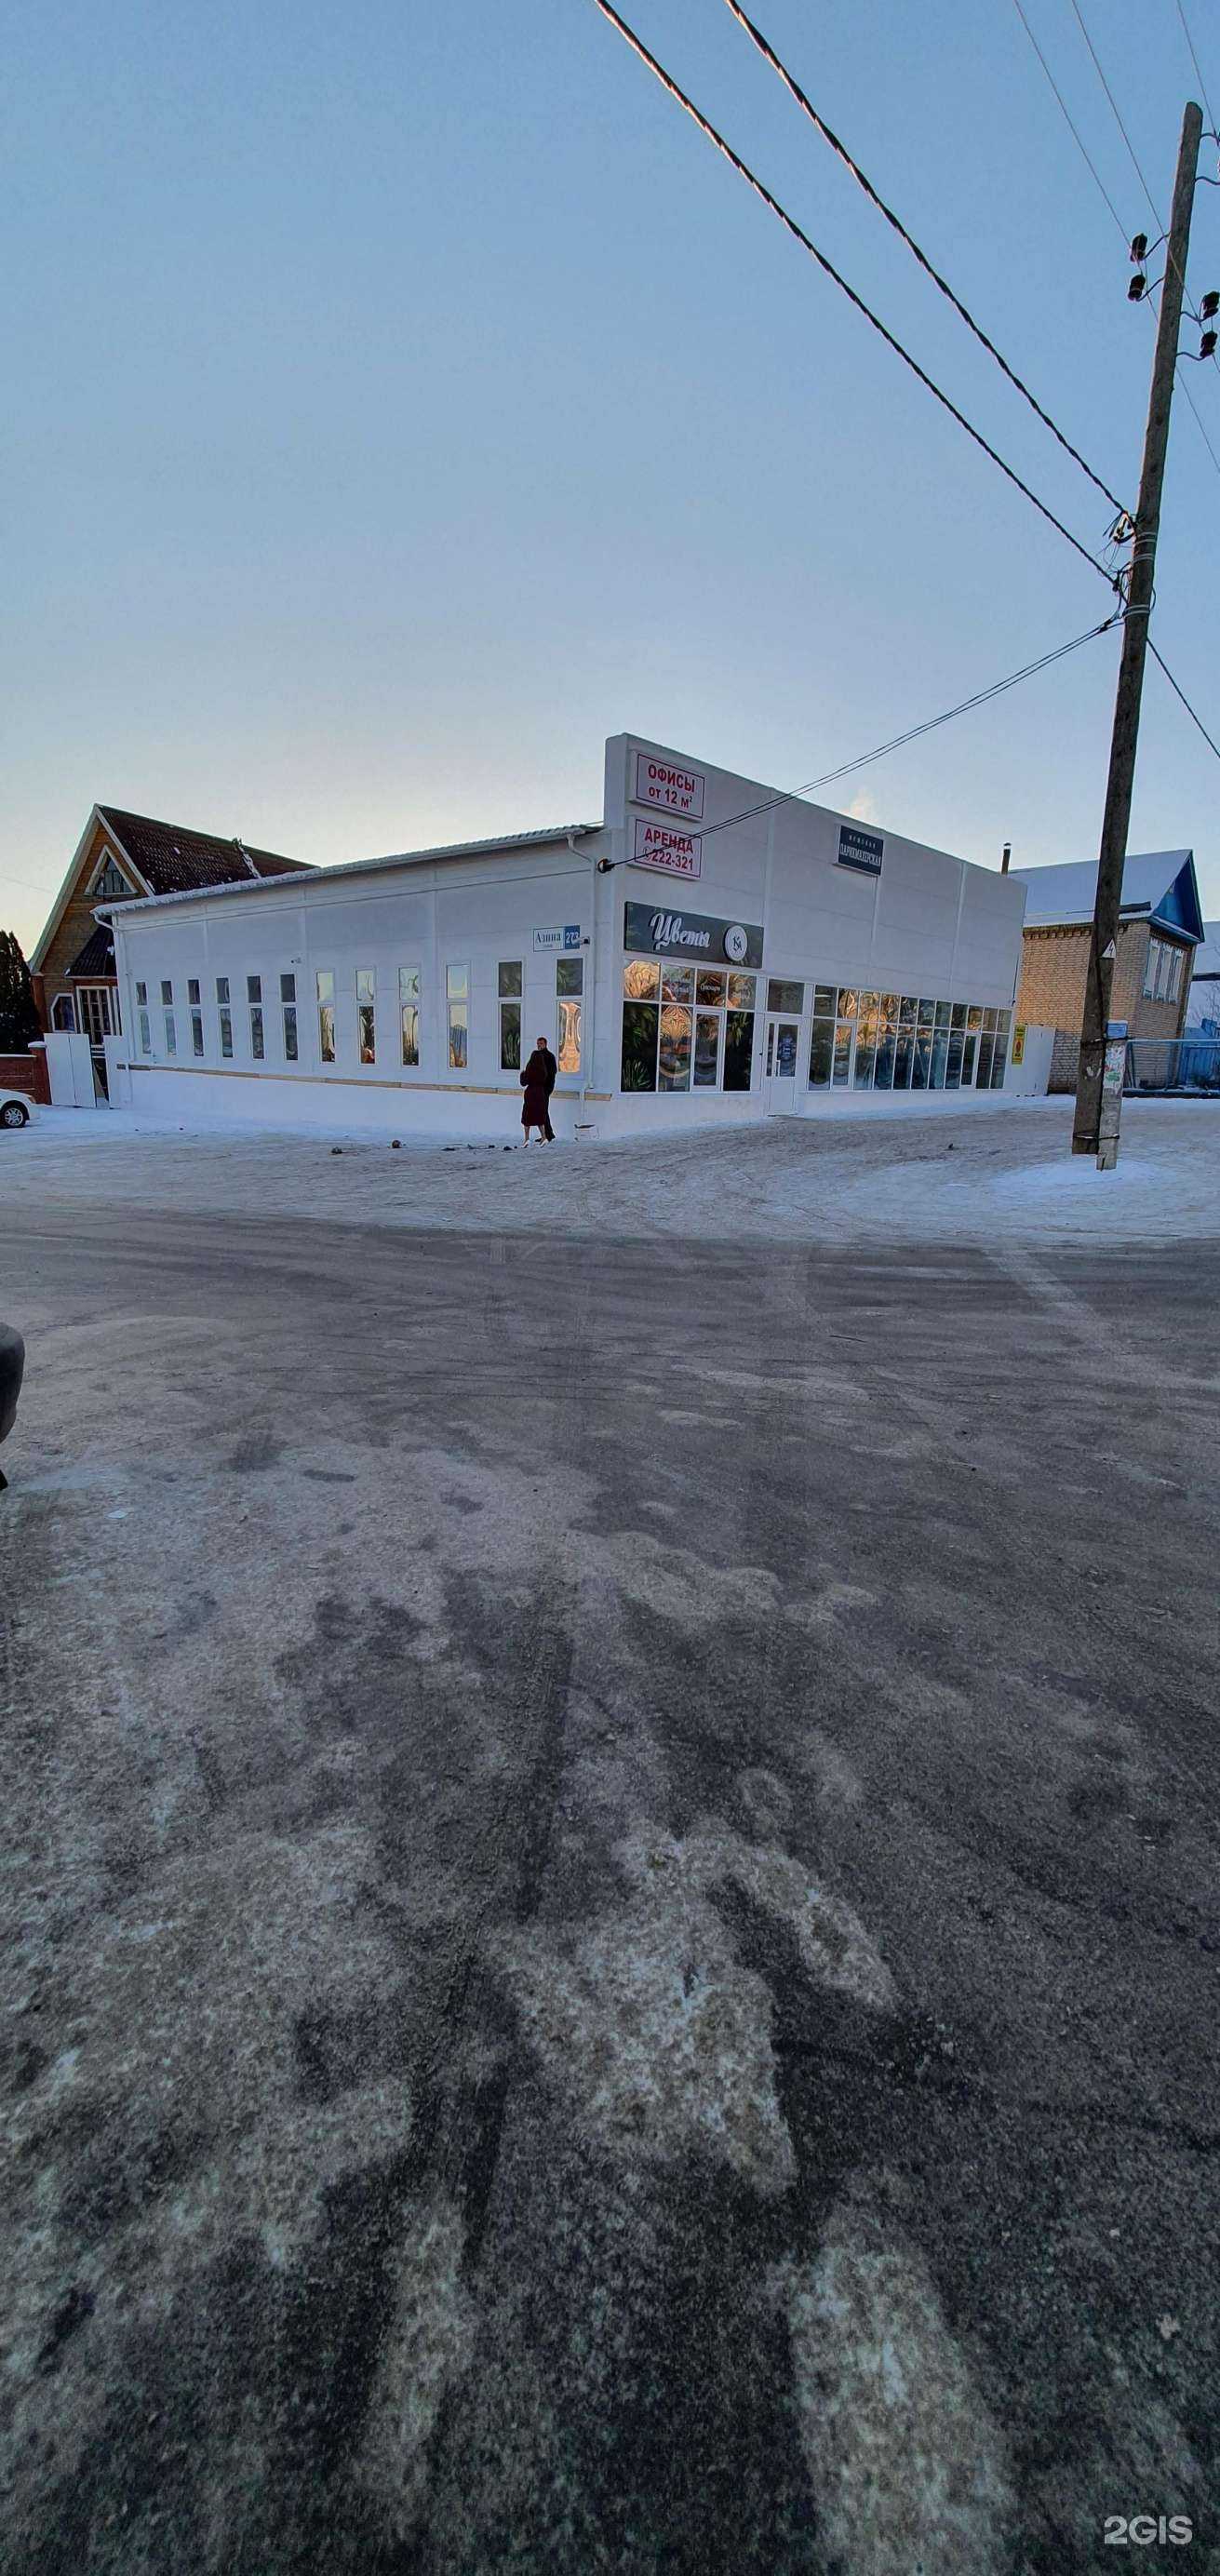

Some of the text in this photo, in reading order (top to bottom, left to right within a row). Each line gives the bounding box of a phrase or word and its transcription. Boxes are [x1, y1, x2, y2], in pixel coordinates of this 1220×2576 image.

[648, 764, 695, 792] ОФИСЫ
[649, 786, 662, 798] от
[664, 788, 678, 805] 12
[644, 827, 694, 853] АРЕНДА
[651, 848, 694, 871] 222-321
[650, 913, 711, 950] Цветы
